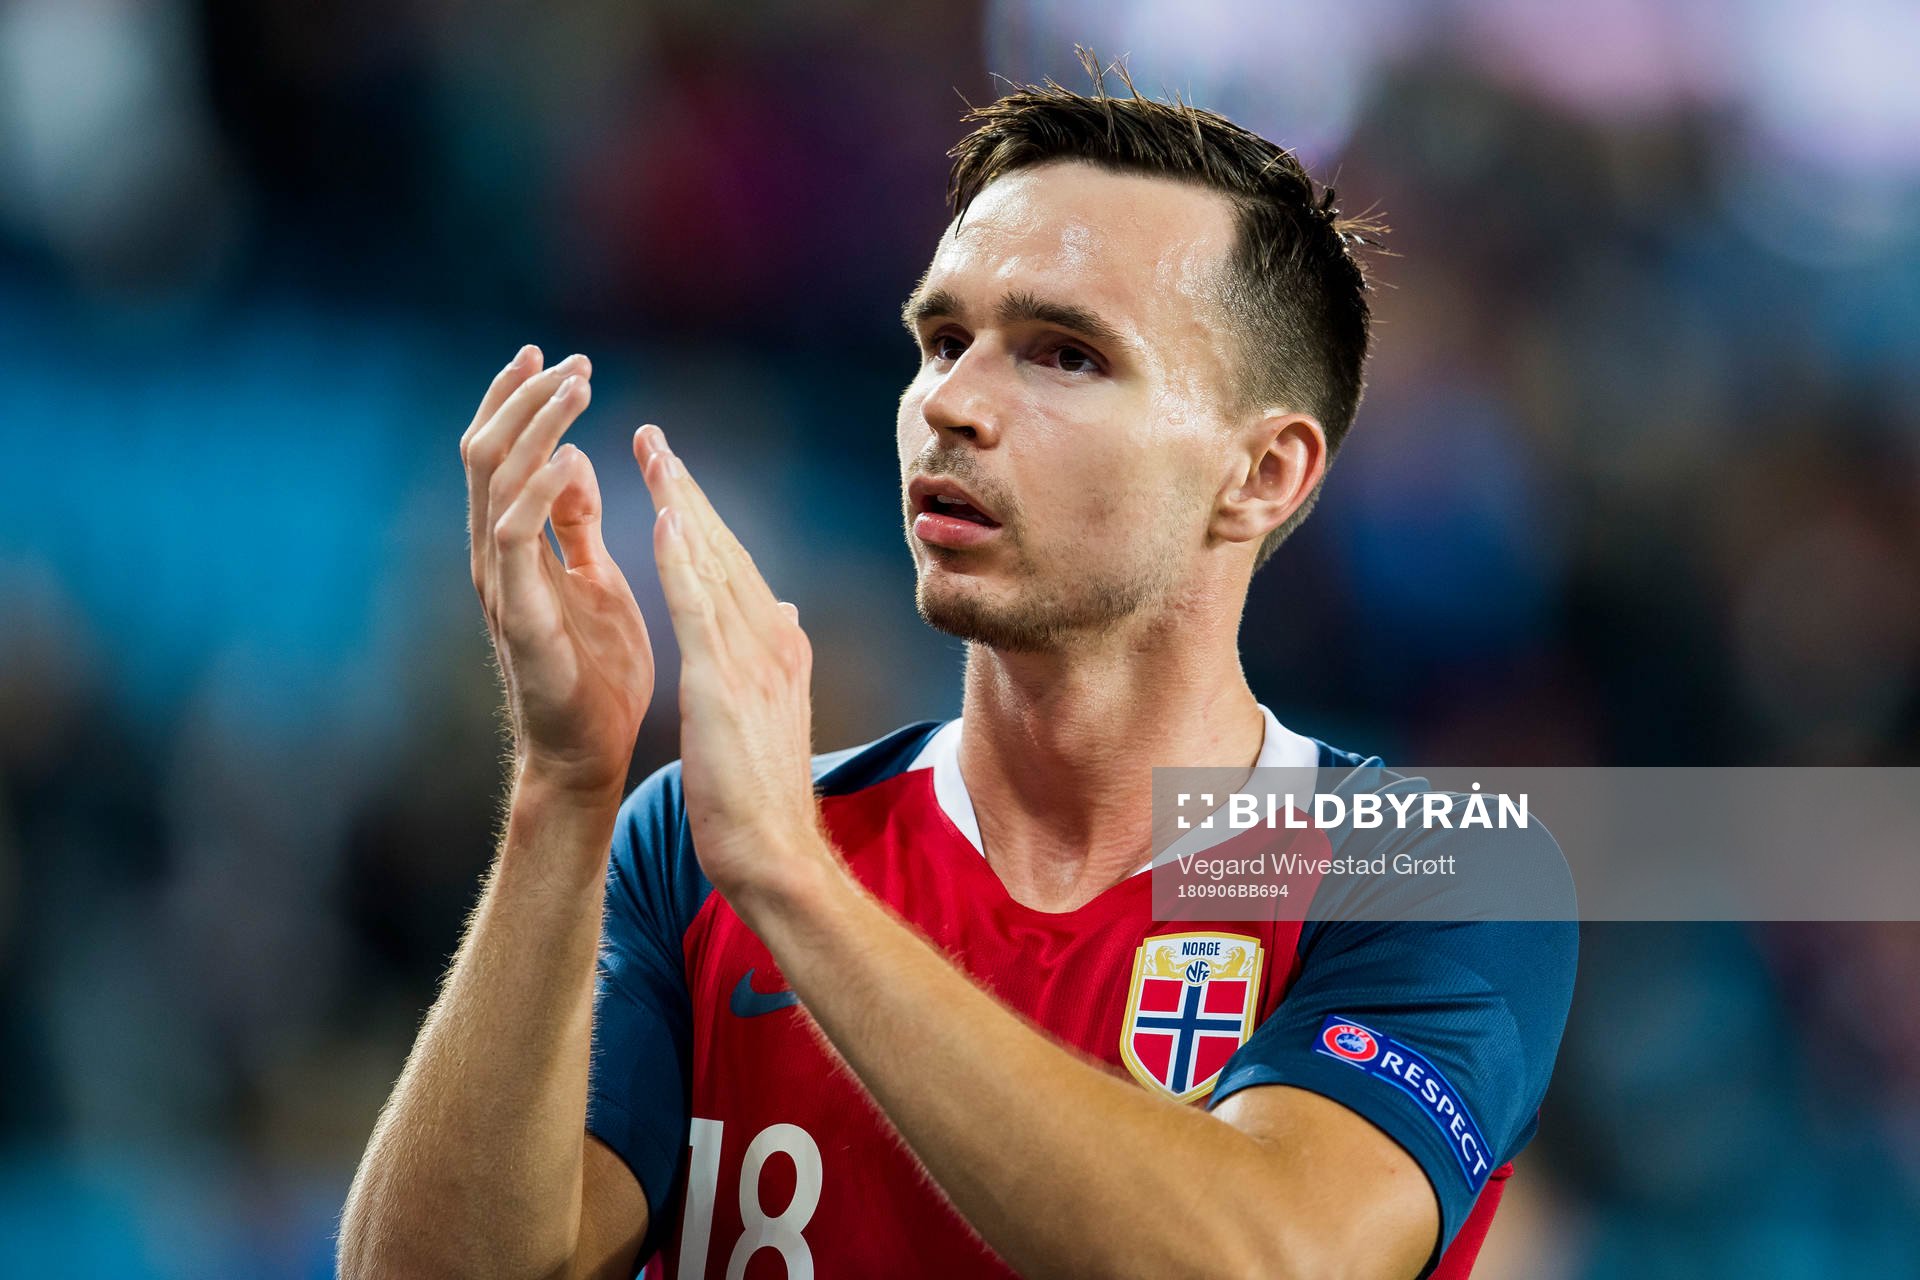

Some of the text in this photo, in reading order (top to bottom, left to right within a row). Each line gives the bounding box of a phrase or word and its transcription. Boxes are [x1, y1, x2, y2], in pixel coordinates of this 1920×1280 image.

[1181, 941, 1221, 956] NORGE
[1339, 1026, 1370, 1045] UEFA
[1380, 1050, 1488, 1176] RESPECT
[677, 1117, 823, 1280] 18
